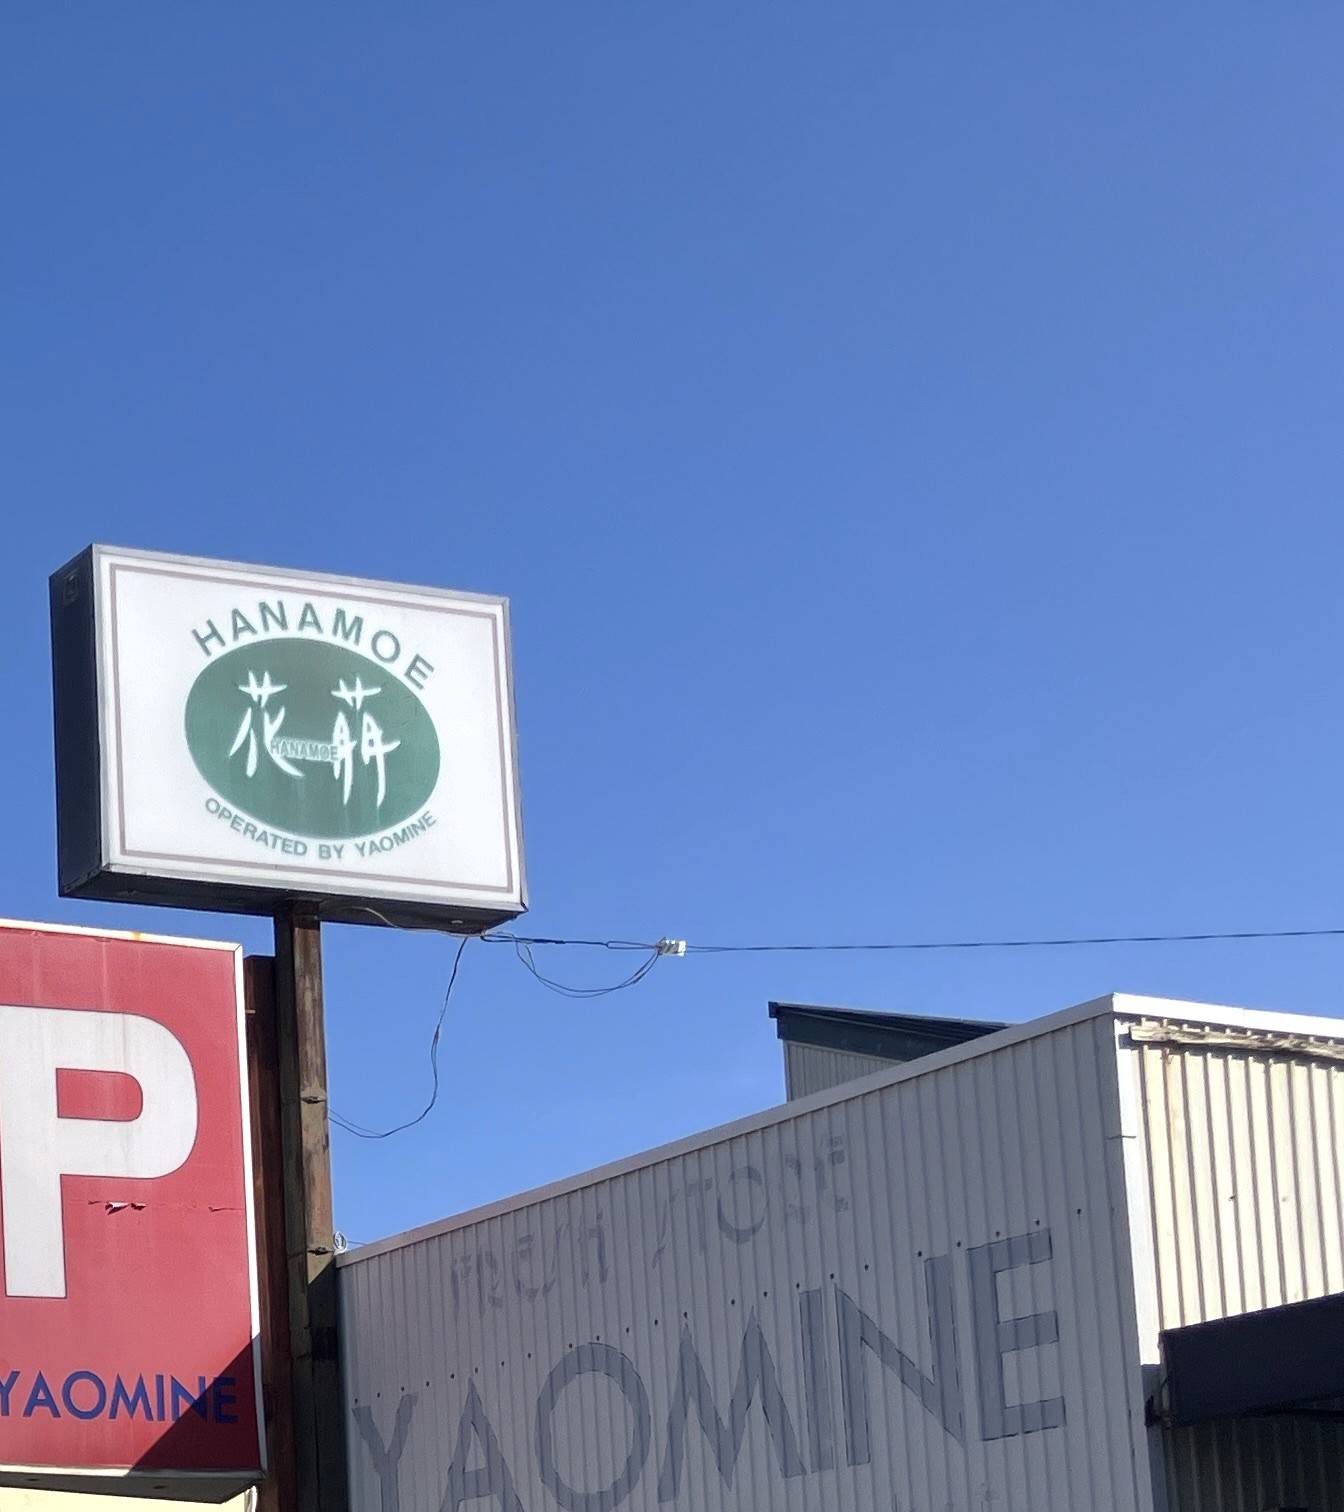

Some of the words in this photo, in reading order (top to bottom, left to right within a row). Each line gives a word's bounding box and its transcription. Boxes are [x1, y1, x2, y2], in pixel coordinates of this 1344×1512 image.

[192, 600, 434, 690] HANAMOE
[205, 798, 308, 857] OPERATED
[318, 843, 345, 860] BY
[355, 811, 437, 858] YAOMINE
